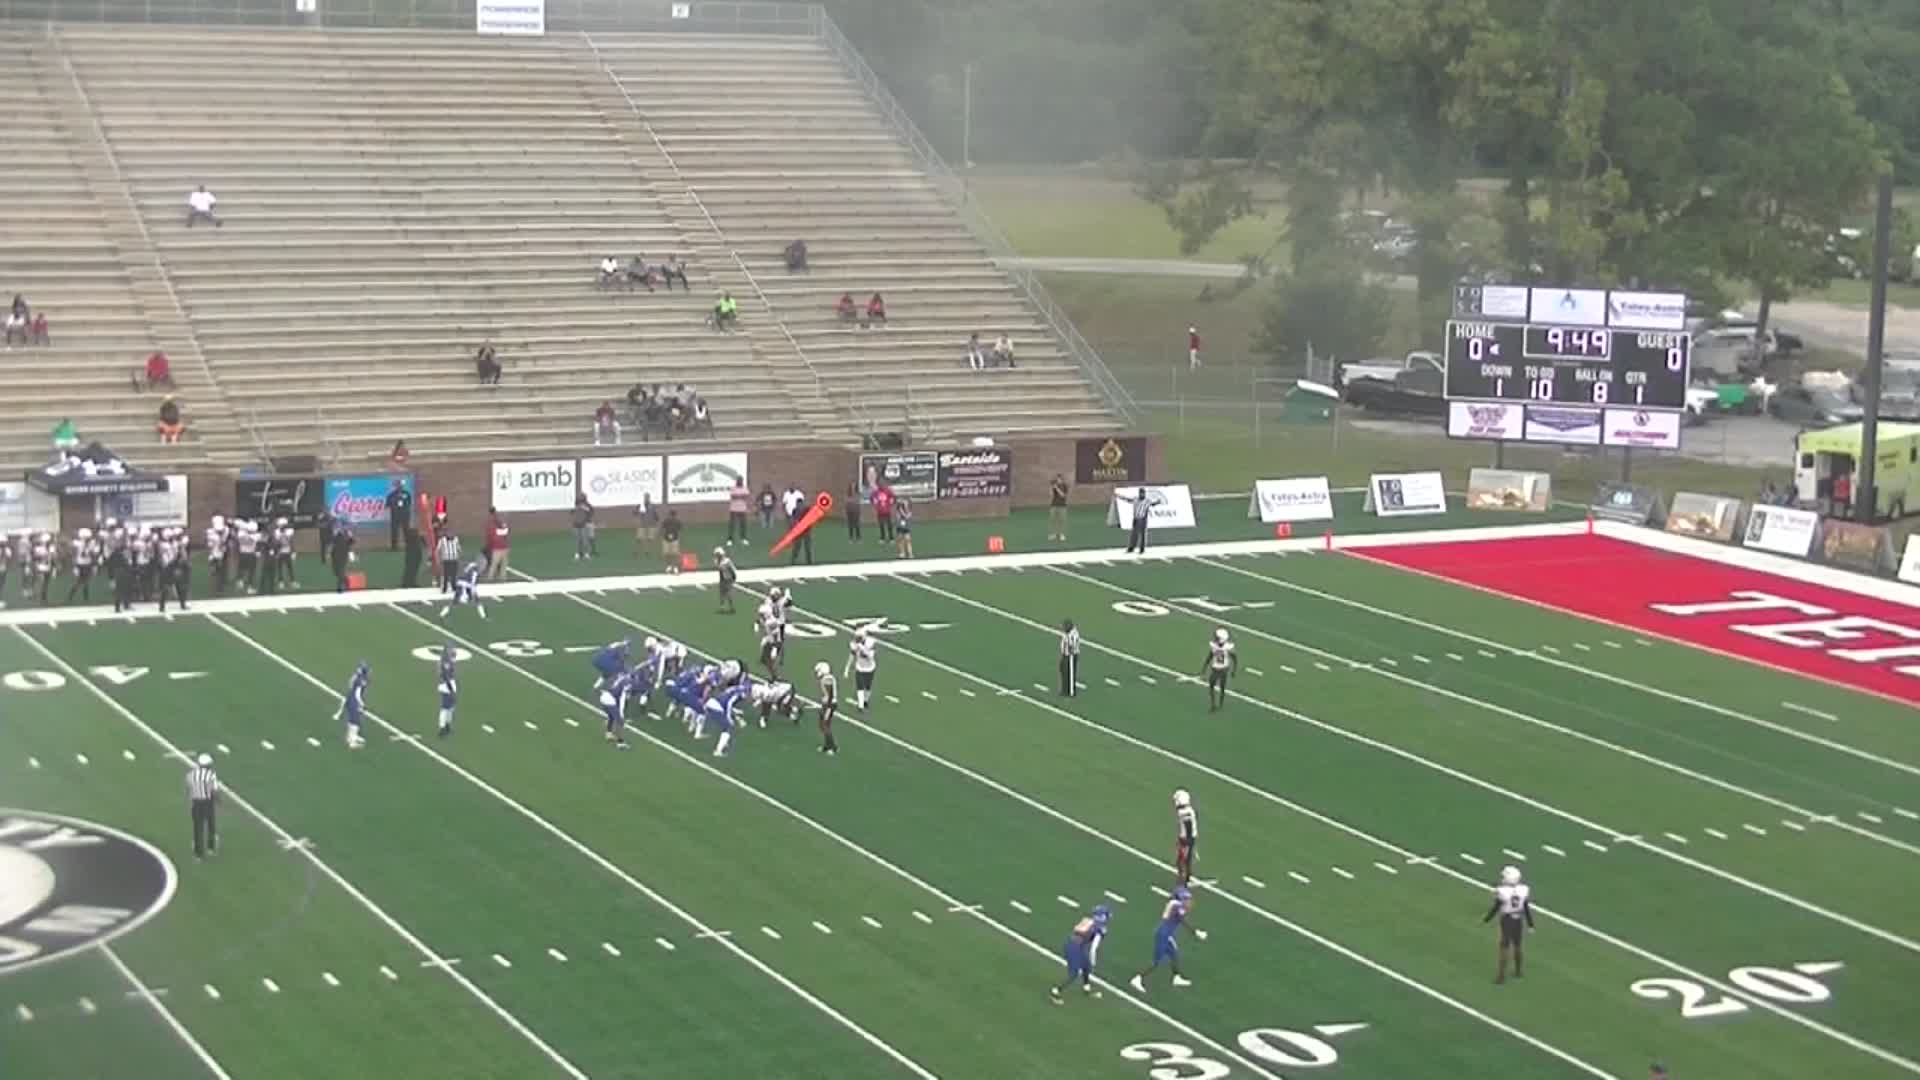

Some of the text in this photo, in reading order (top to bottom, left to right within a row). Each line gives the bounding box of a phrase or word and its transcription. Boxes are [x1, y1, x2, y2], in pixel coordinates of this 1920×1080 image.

[1456, 324, 1495, 338] HOME
[1637, 333, 1682, 348] GUEST
[1468, 338, 1483, 360] 0
[1547, 329, 1608, 355] 9:49
[1667, 347, 1682, 370] 0
[1481, 365, 1512, 378] DOWN
[1524, 366, 1538, 378] TO
[1575, 370, 1599, 382] BALL
[1496, 378, 1503, 398] 1
[1531, 380, 1553, 401] 10
[1592, 382, 1608, 403] 8
[1636, 386, 1644, 405] 1
[519, 464, 573, 488] amb
[1630, 965, 1832, 1018] 20
[1120, 1027, 1340, 1080] 30
